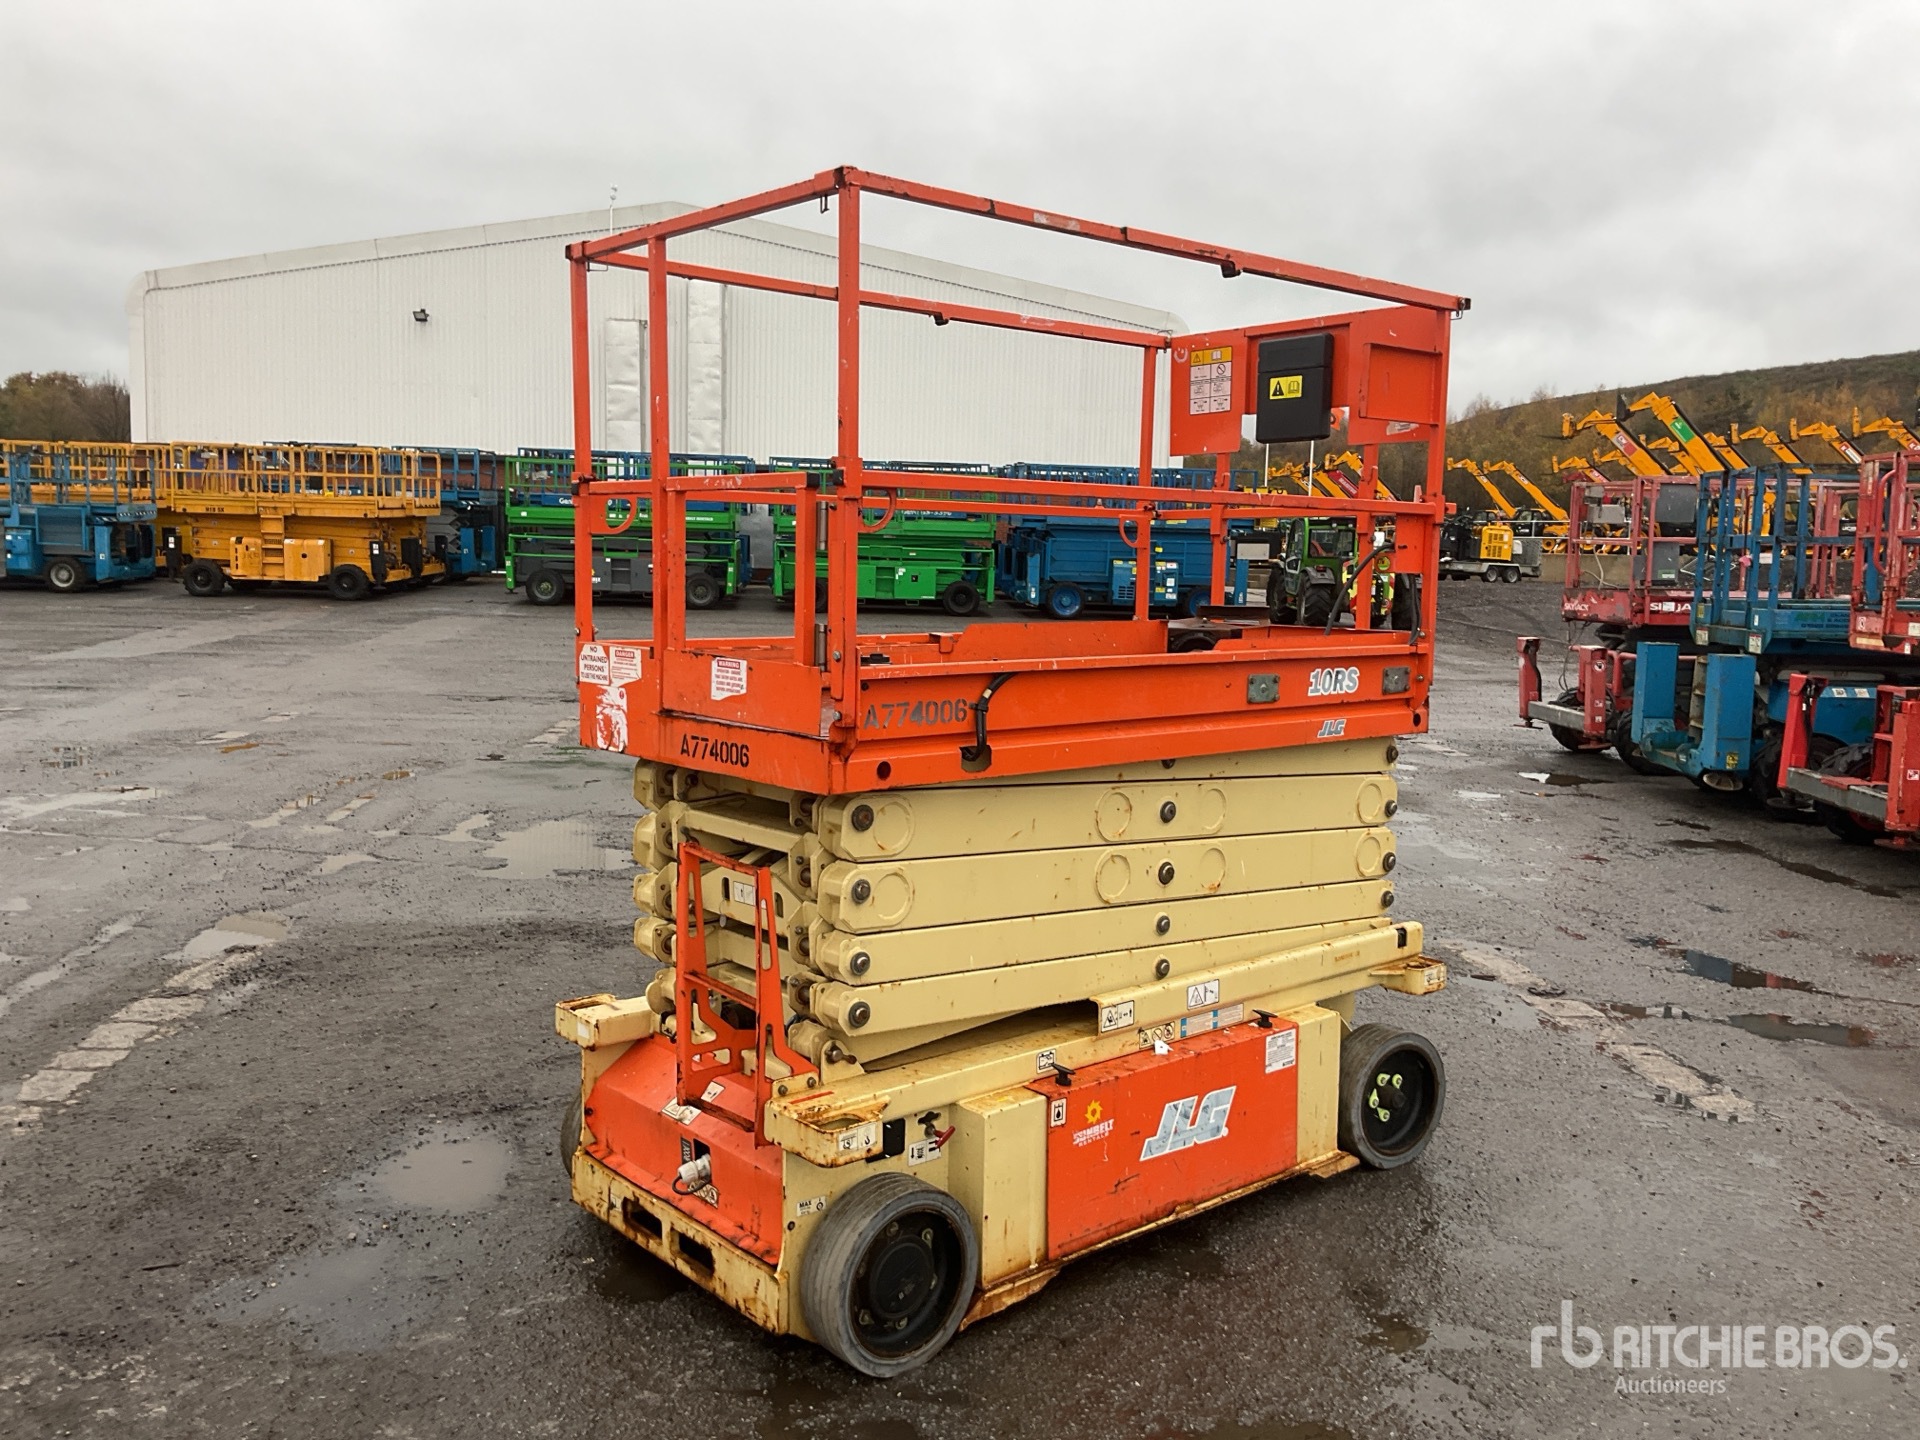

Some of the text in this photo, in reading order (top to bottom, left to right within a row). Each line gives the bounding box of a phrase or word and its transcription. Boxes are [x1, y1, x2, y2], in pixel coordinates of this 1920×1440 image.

[581, 655, 607, 663] UNTRAINED
[584, 664, 604, 672] PERSONS
[1308, 666, 1360, 696] 10RS
[864, 698, 967, 729] A774006
[1317, 718, 1347, 738] JLG
[681, 733, 749, 768] A774006
[1139, 1085, 1236, 1161] JLG
